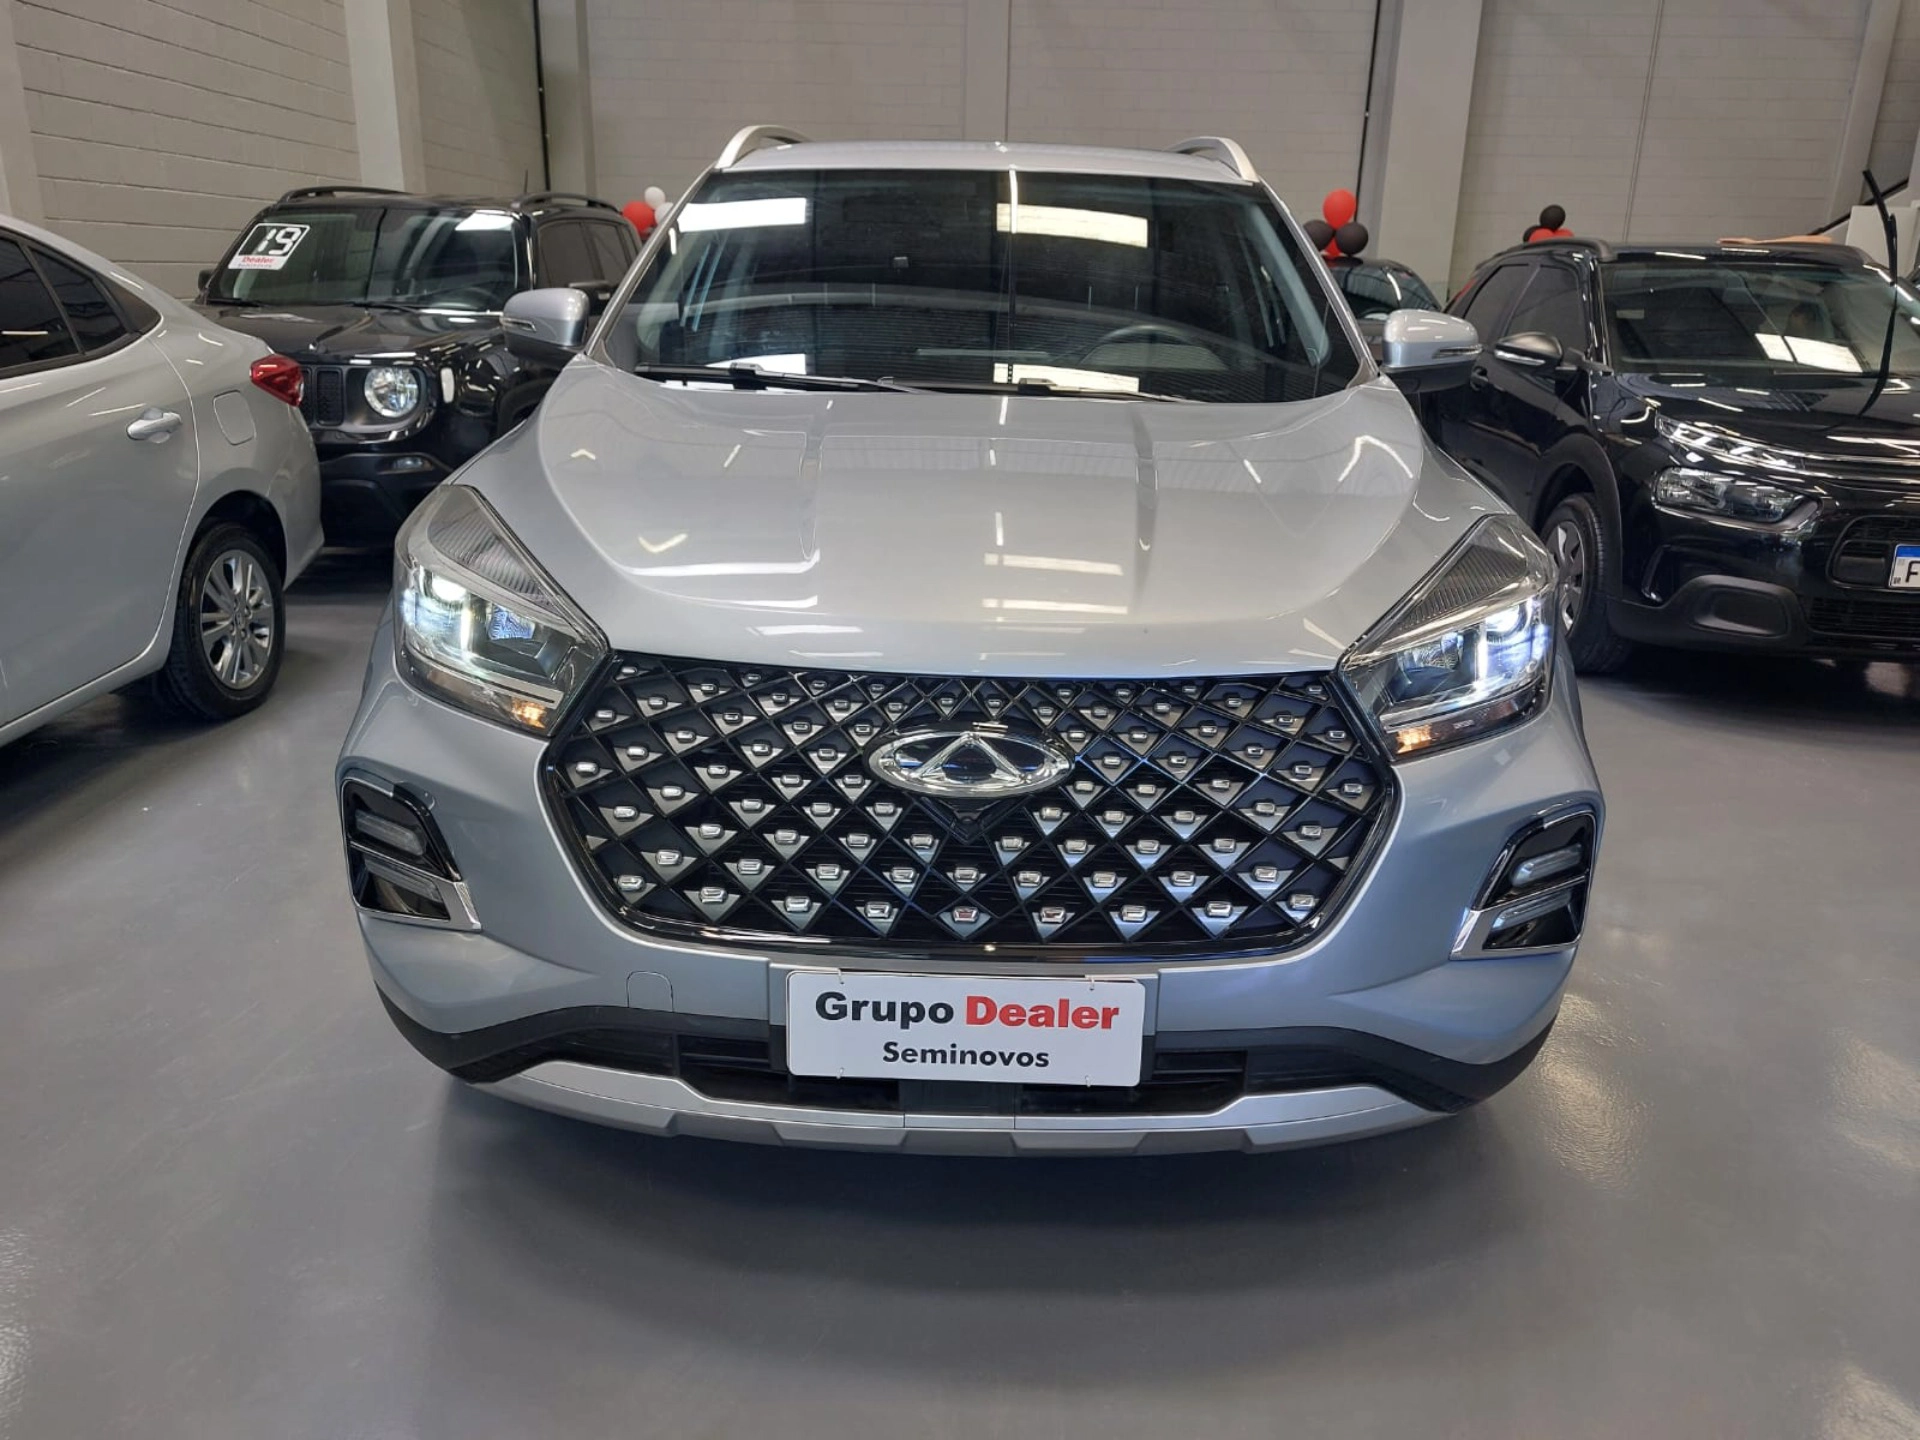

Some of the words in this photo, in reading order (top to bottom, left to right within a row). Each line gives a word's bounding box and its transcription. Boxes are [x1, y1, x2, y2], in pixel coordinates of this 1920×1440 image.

[258, 227, 301, 255] 19
[815, 991, 954, 1030] Grupo
[965, 995, 1119, 1030] Dealer
[883, 1041, 1050, 1068] Seminovos
